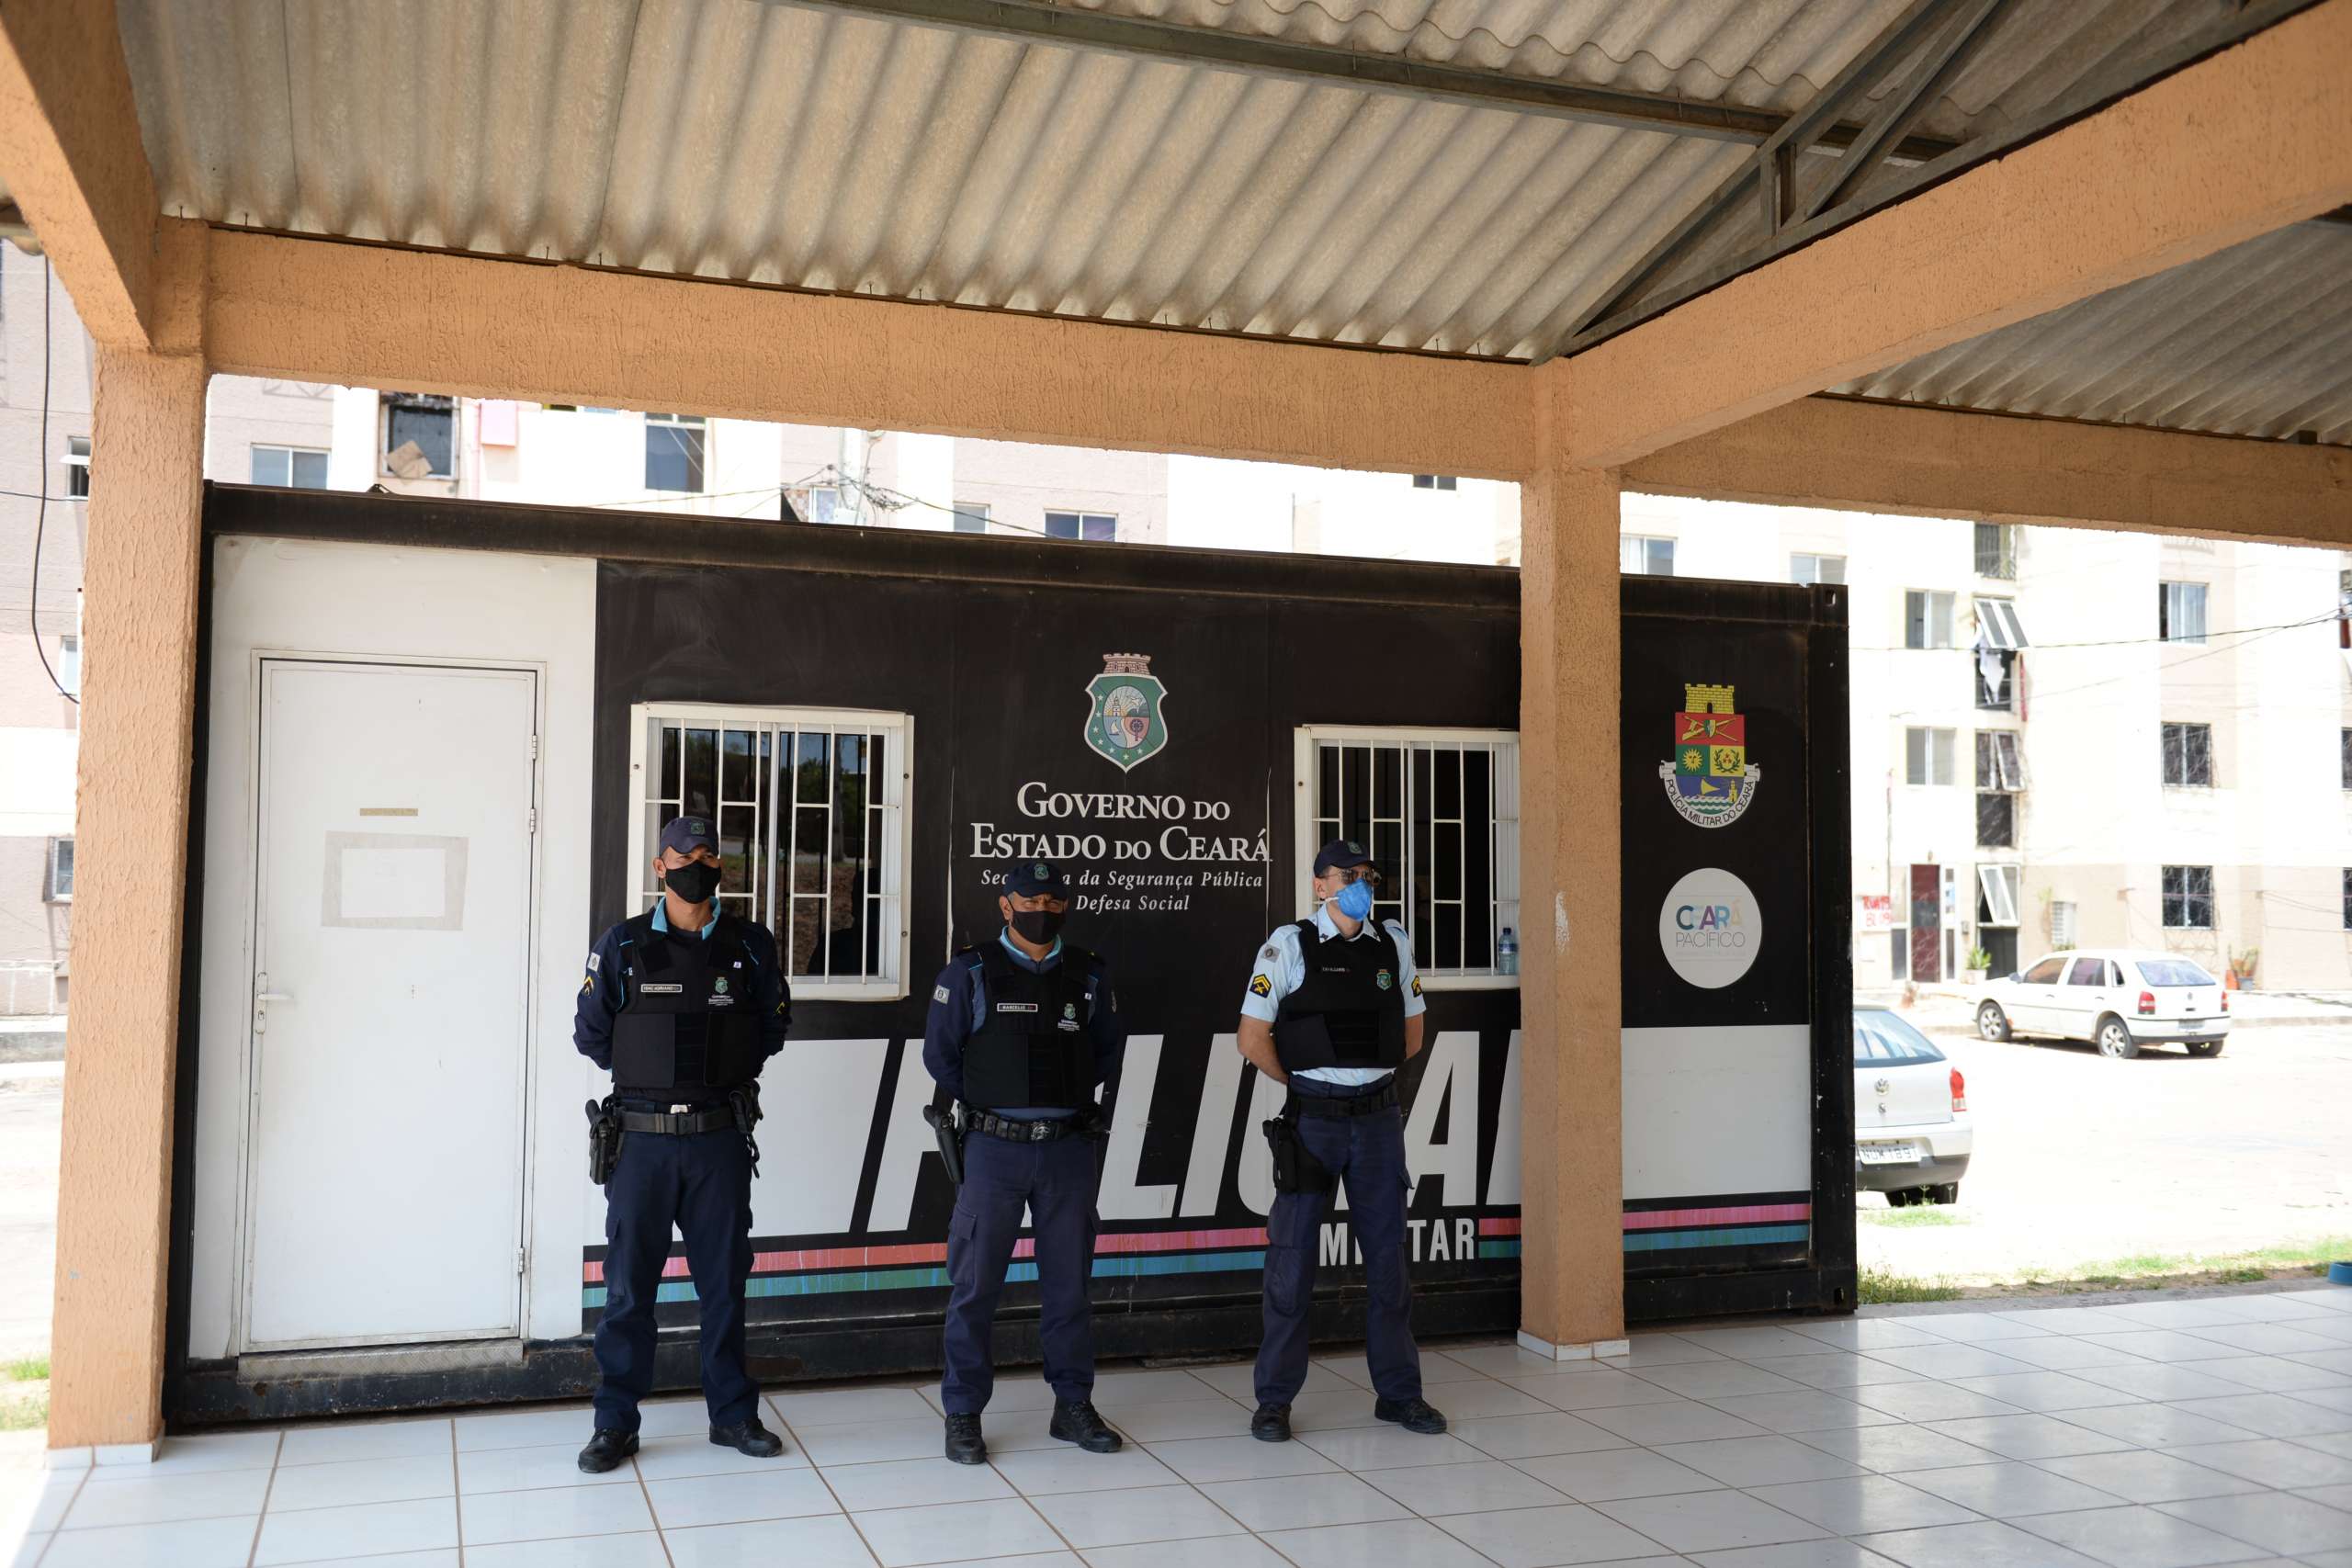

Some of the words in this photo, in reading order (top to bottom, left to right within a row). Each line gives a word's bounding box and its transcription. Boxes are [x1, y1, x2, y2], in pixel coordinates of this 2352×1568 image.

[1016, 781, 1186, 820] GOVERNO
[1193, 800, 1231, 820] DO
[1688, 811, 1722, 826] MILITAR
[1723, 809, 1736, 822] DO
[969, 822, 1107, 860] ESTADO
[1114, 840, 1152, 861] DO
[1159, 826, 1273, 863] CEARÁ
[1080, 869, 1100, 886] da
[1107, 871, 1193, 891] Segurança
[1201, 871, 1263, 888] Pública
[1076, 895, 1131, 915] Defesa
[1138, 895, 1191, 911] Social
[1676, 929, 1746, 948] PACÍFICO
[866, 1031, 1480, 1233] PLIA
[1318, 1218, 1476, 1267] MTAR
